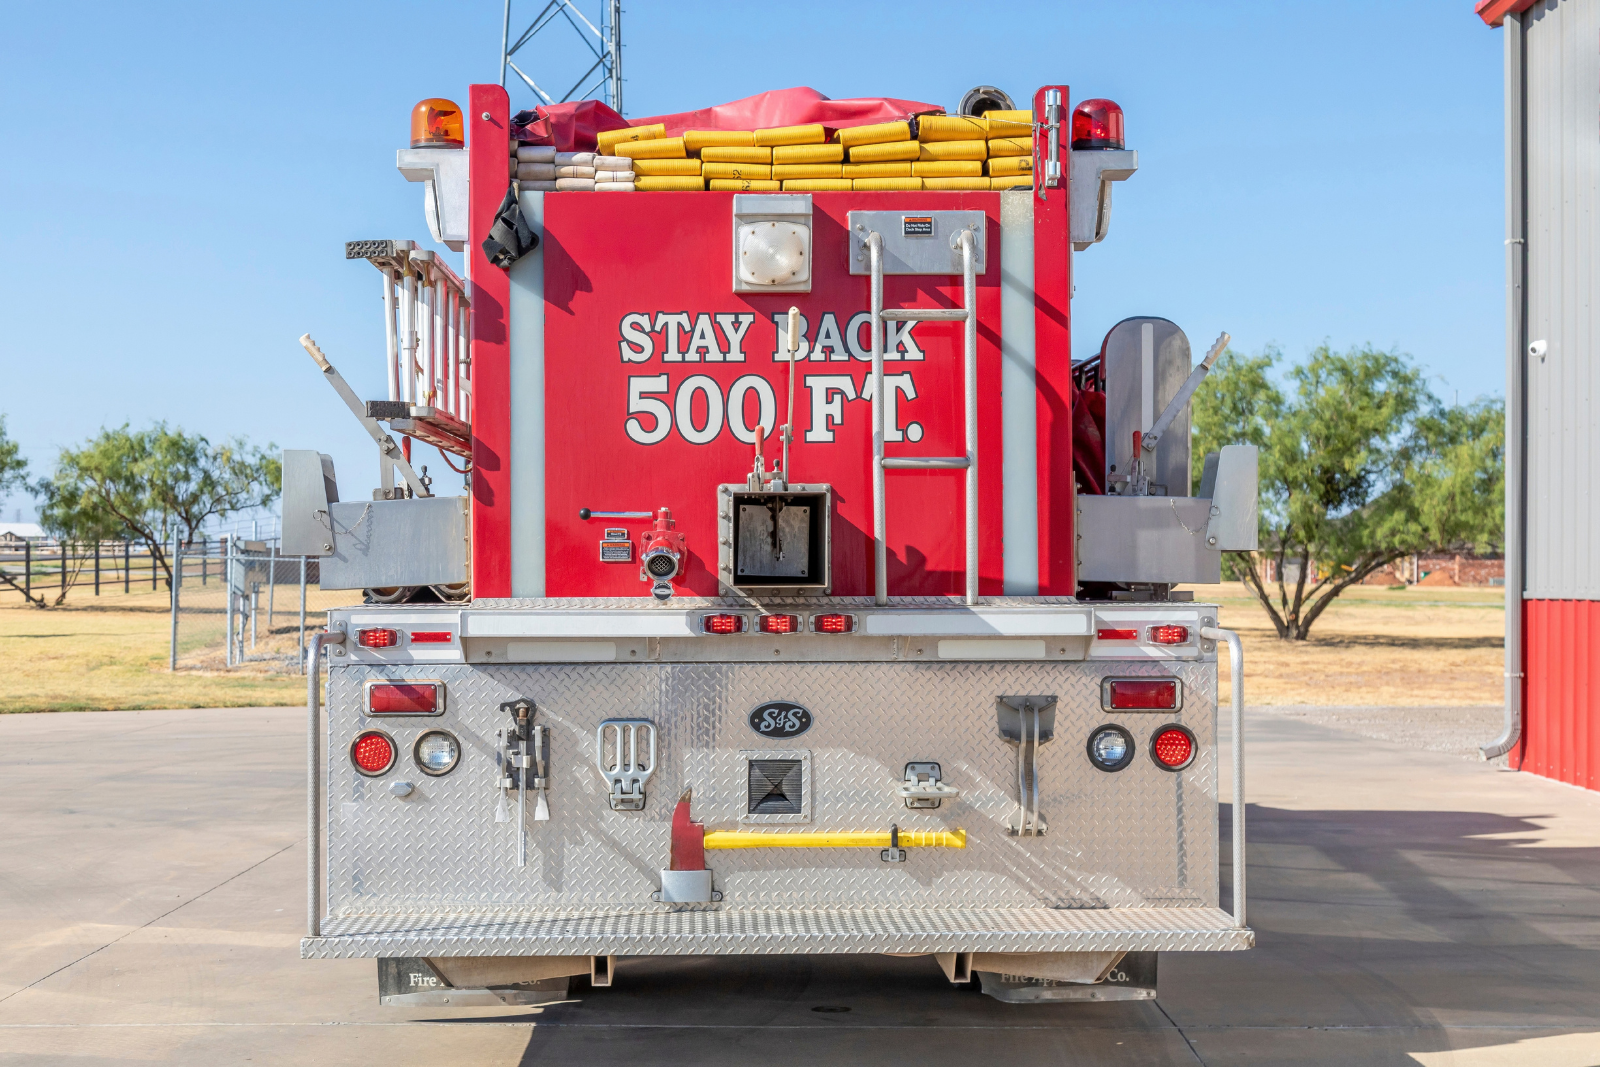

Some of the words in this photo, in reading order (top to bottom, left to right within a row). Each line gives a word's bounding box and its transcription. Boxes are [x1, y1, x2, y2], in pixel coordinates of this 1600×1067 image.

[618, 311, 755, 363] STAY
[772, 311, 925, 362] BACK
[624, 373, 777, 445] 500
[804, 371, 924, 443] FT.
[760, 708, 803, 732] S&S
[409, 973, 437, 987] Fire
[1107, 968, 1130, 982] Co.
